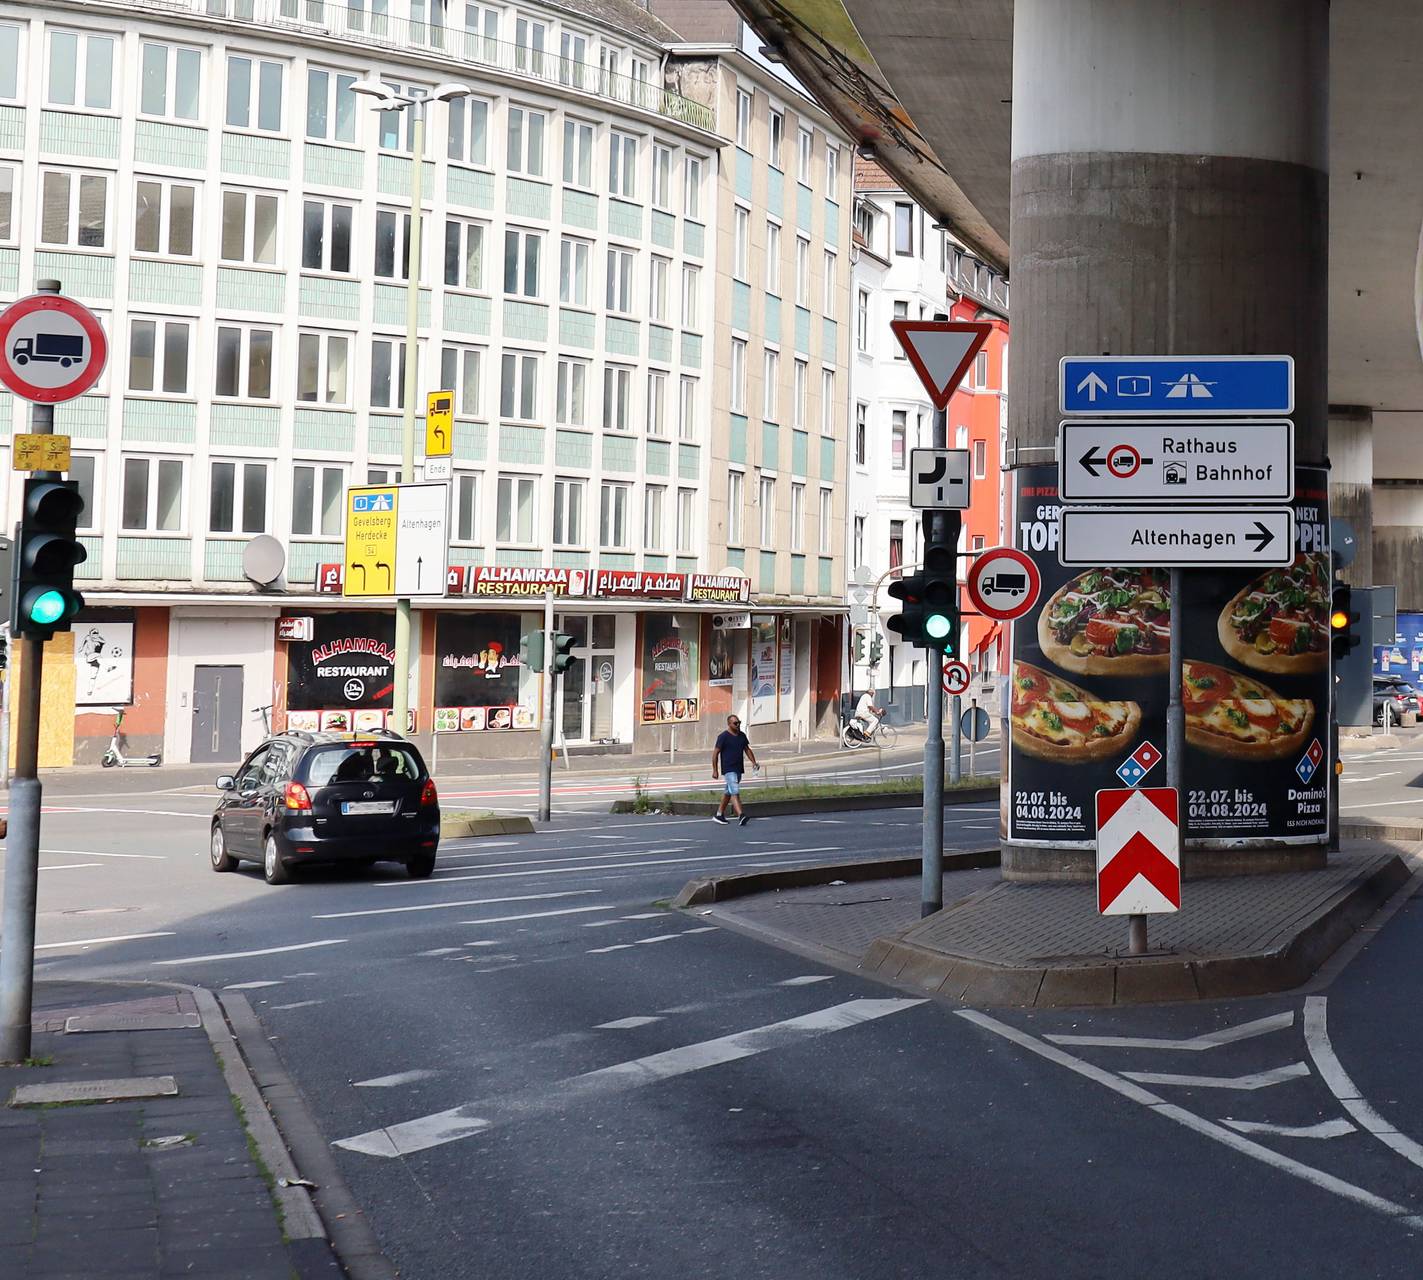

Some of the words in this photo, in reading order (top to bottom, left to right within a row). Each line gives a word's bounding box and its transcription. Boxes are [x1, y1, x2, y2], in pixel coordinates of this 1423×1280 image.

[1131, 380, 1136, 392] 1
[1162, 437, 1237, 453] Rathaus
[429, 464, 446, 473] Ende
[1196, 464, 1272, 481] Bahnhof
[1036, 505, 1060, 520] GER
[1296, 506, 1319, 521] NEXT
[353, 517, 391, 528] Gevelsberg
[402, 519, 441, 531] Altenhagen
[355, 530, 388, 540] Herdecke
[1020, 521, 1060, 552] TOP
[1131, 529, 1236, 550] Altenhagen
[478, 568, 567, 581] ALHAMRAA
[476, 582, 567, 595] RESTAURANT
[694, 576, 740, 589] ALHAMRAA
[693, 589, 740, 600] RESTAURANT
[312, 638, 397, 665] ALHAMRAA
[317, 666, 389, 677] RESTAURANT
[1015, 791, 1047, 805] 22.07.
[1050, 791, 1068, 805] bis
[1188, 790, 1231, 803] 22.07.
[1235, 789, 1254, 803] bis
[1288, 787, 1326, 801] Domino's
[1016, 805, 1082, 820] 04.08.2024
[1189, 803, 1267, 817] 04.08.2024
[1297, 802, 1320, 814] Pizza
